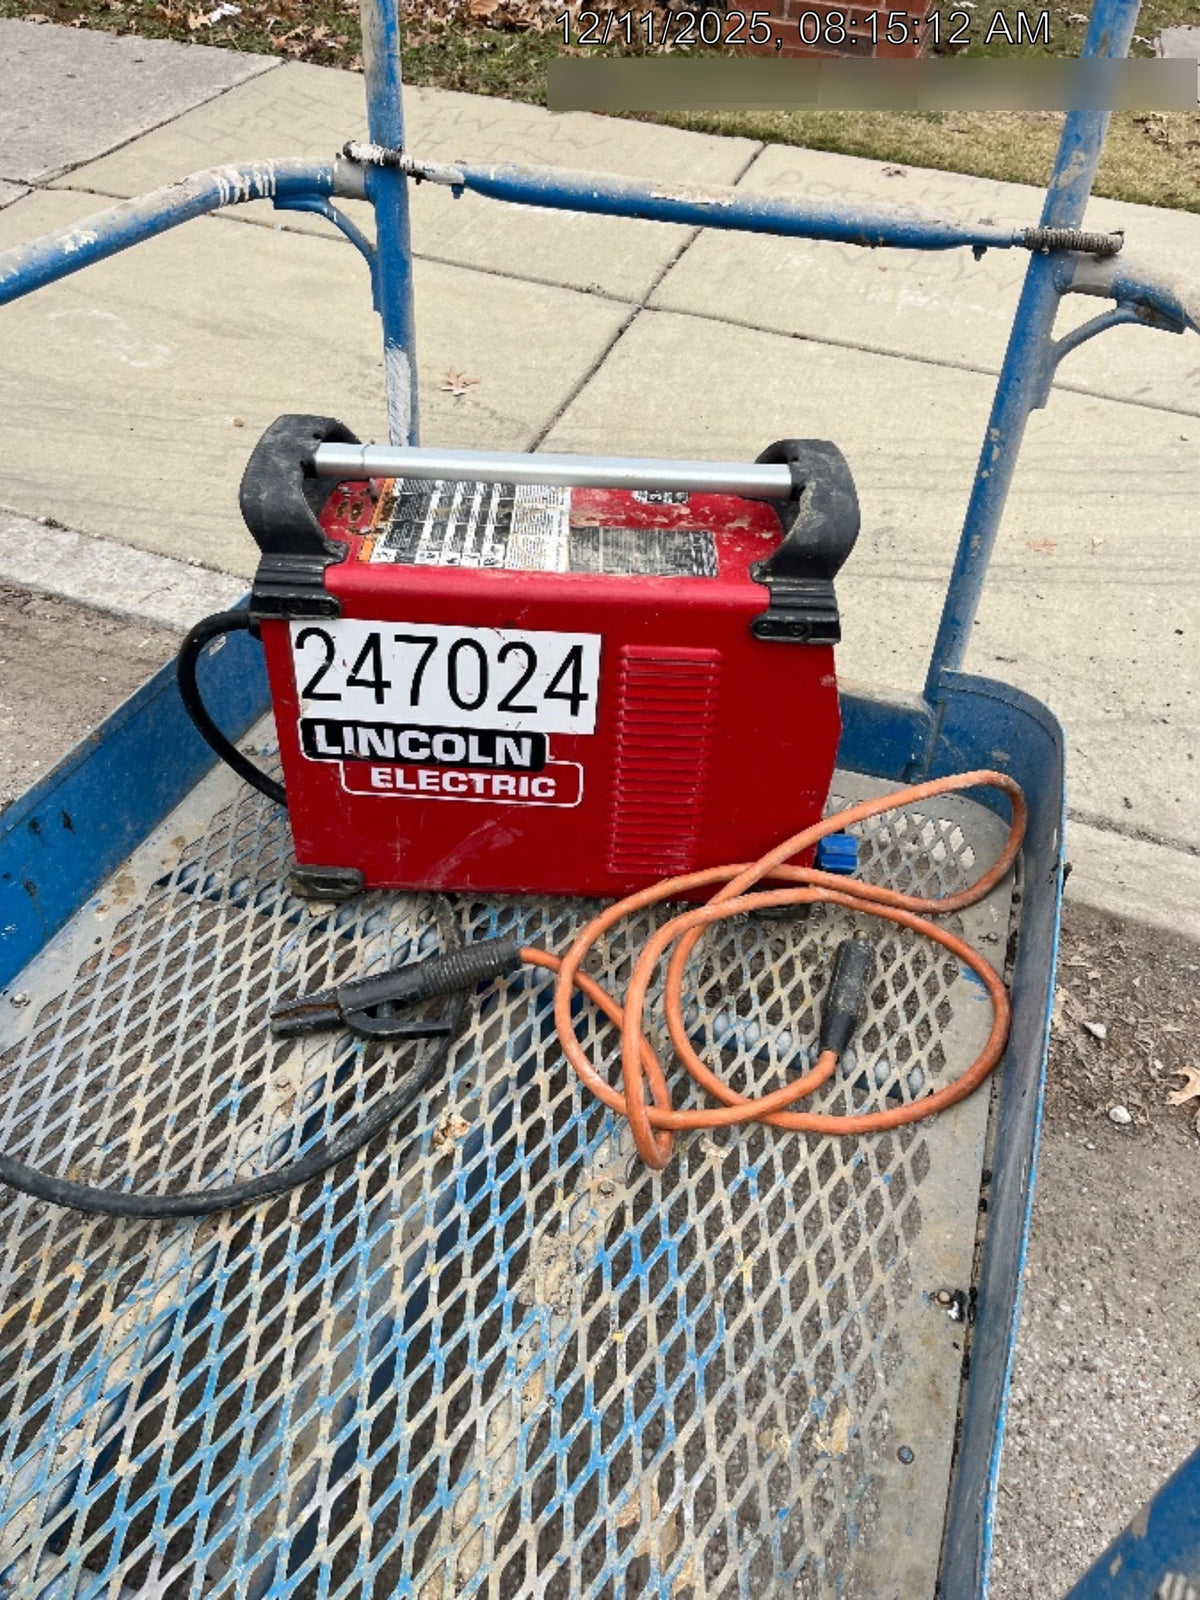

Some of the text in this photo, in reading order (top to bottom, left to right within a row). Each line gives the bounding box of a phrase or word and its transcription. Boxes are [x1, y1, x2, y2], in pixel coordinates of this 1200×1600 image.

[295, 627, 589, 717] 247024
[313, 724, 532, 767] LINCOLN
[370, 767, 556, 798] ELECTRIC
